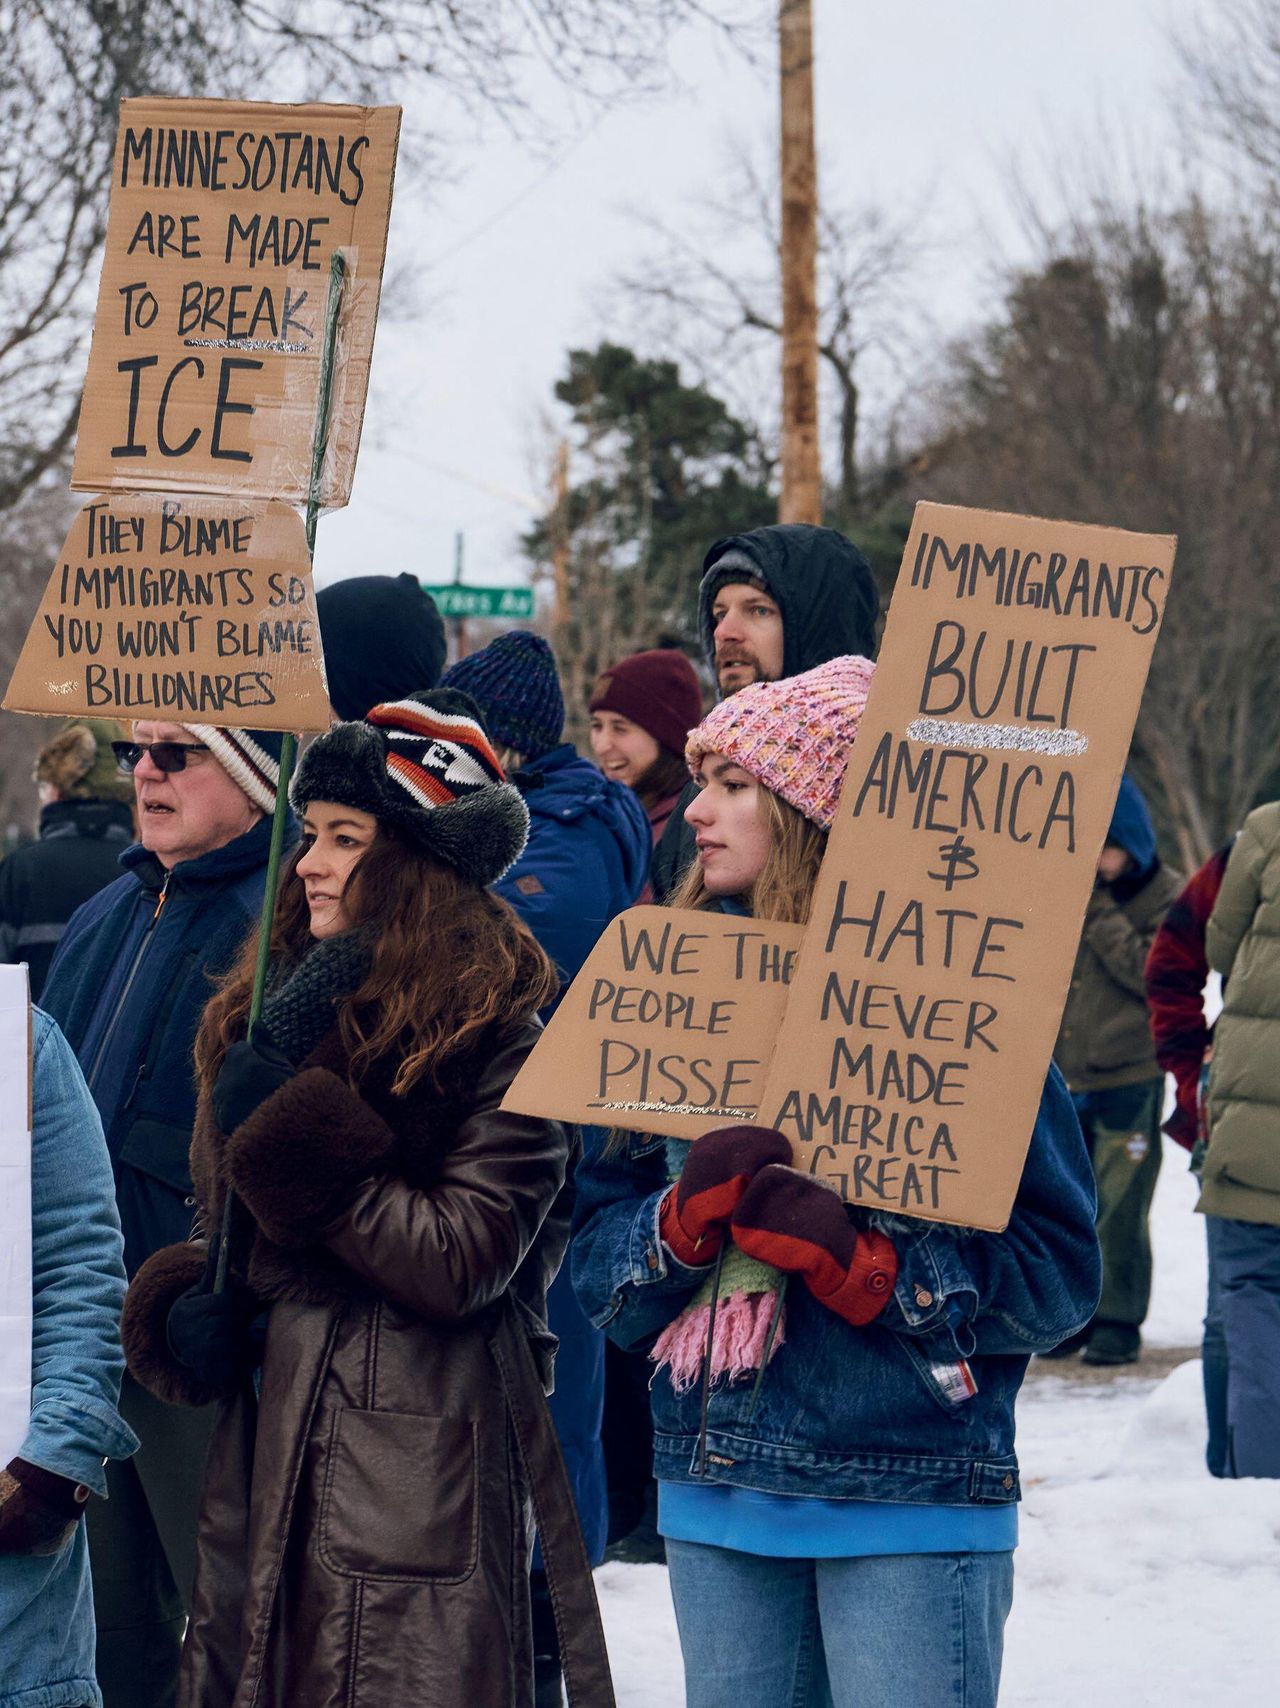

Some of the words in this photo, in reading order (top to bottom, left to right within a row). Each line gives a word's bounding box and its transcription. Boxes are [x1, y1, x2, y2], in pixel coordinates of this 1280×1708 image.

[121, 127, 370, 206] MINNESOTANS
[127, 211, 201, 258] ARE
[226, 213, 330, 271] MADE
[118, 281, 158, 337] TO
[177, 283, 314, 340] BREAK
[110, 355, 264, 462] ICE
[83, 503, 146, 559] THEY
[159, 501, 252, 557] BLAME
[60, 567, 254, 608] IMMIGRANTS
[268, 572, 305, 605] SO
[911, 533, 1164, 634] IMMIGRANTS
[44, 613, 103, 658] YOU
[119, 611, 196, 658] WON'T
[217, 618, 313, 658] BLAME
[85, 663, 276, 709] BILLIONARES
[919, 620, 1096, 729] BUILT
[853, 732, 1075, 853] AMERICA
[619, 919, 709, 975] WE
[723, 933, 797, 985] THE
[825, 881, 1024, 982] HATE
[588, 978, 738, 1034] PEOPLE
[821, 972, 999, 1052] NEVER
[829, 1037, 969, 1106] MADE
[774, 1091, 957, 1161] AMERICA
[809, 1145, 961, 1209] GREAT
